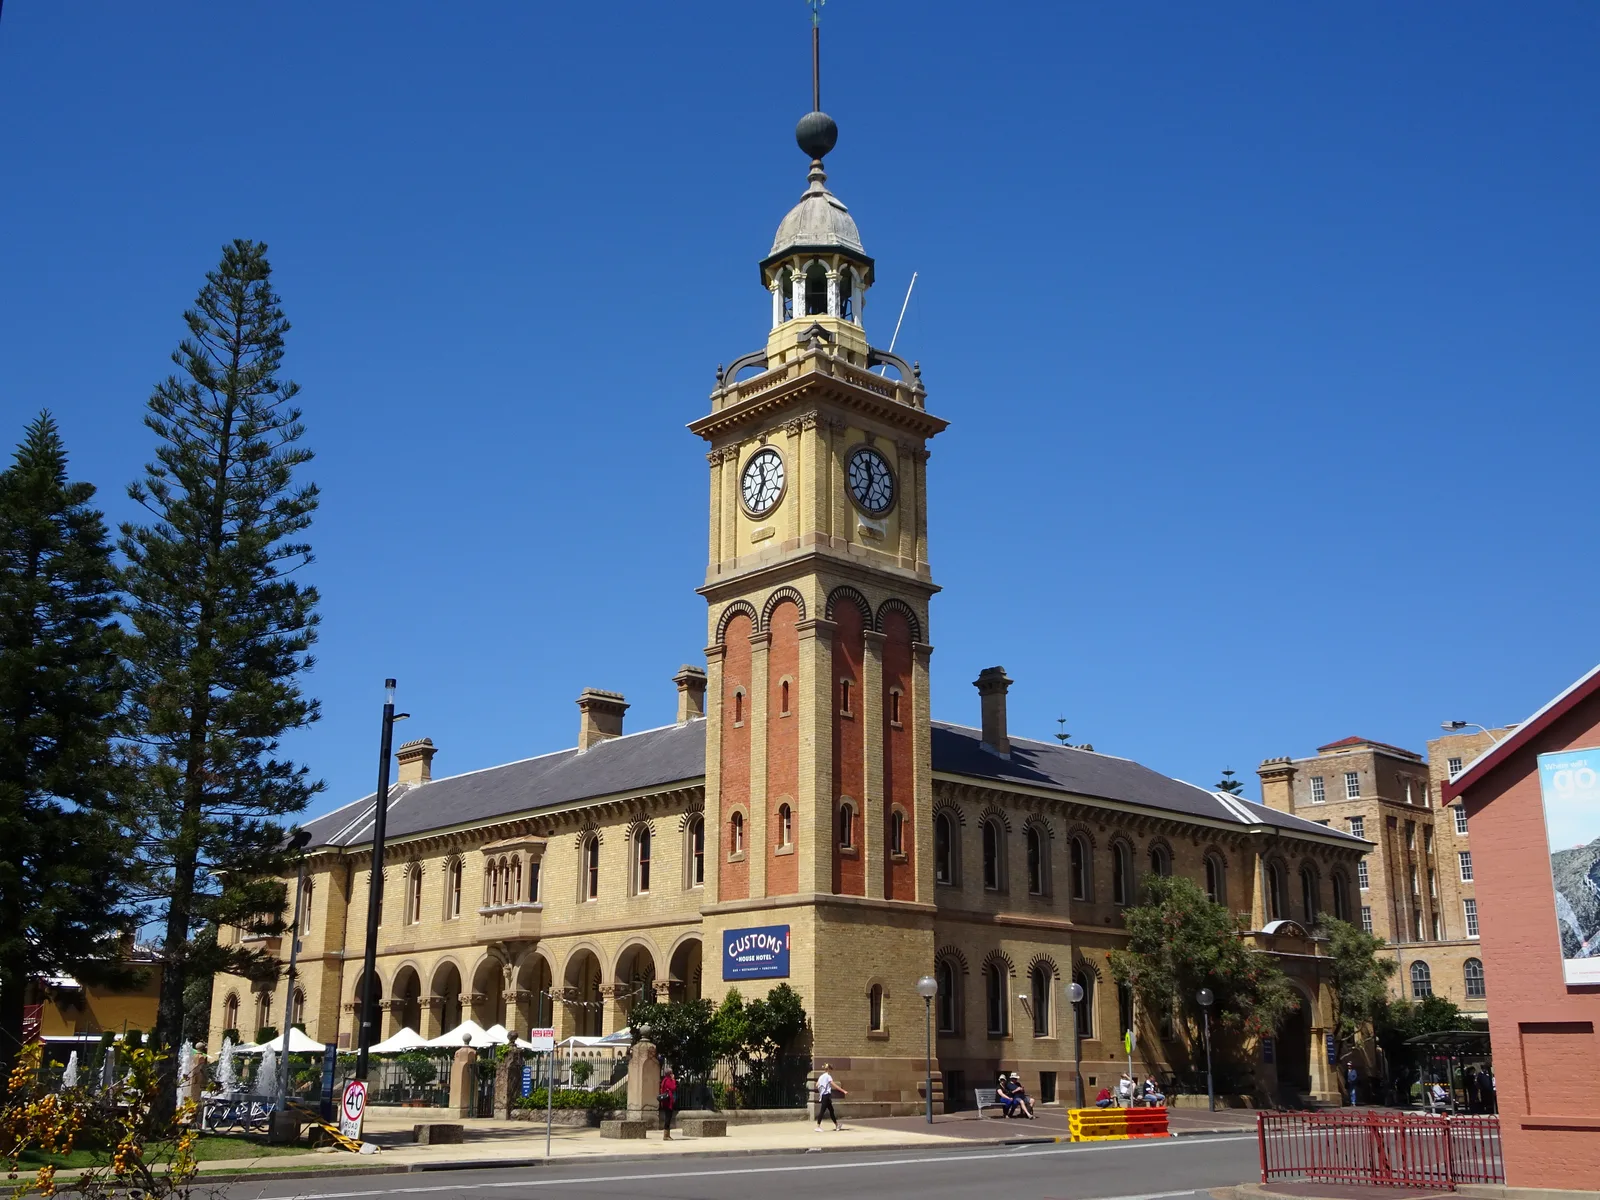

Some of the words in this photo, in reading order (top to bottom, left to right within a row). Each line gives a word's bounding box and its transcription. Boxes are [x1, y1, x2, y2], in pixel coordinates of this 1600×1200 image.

[1553, 767, 1597, 799] go
[729, 934, 782, 957] CUSTOMS
[346, 1092, 363, 1111] 40
[344, 1121, 358, 1130] ROAD
